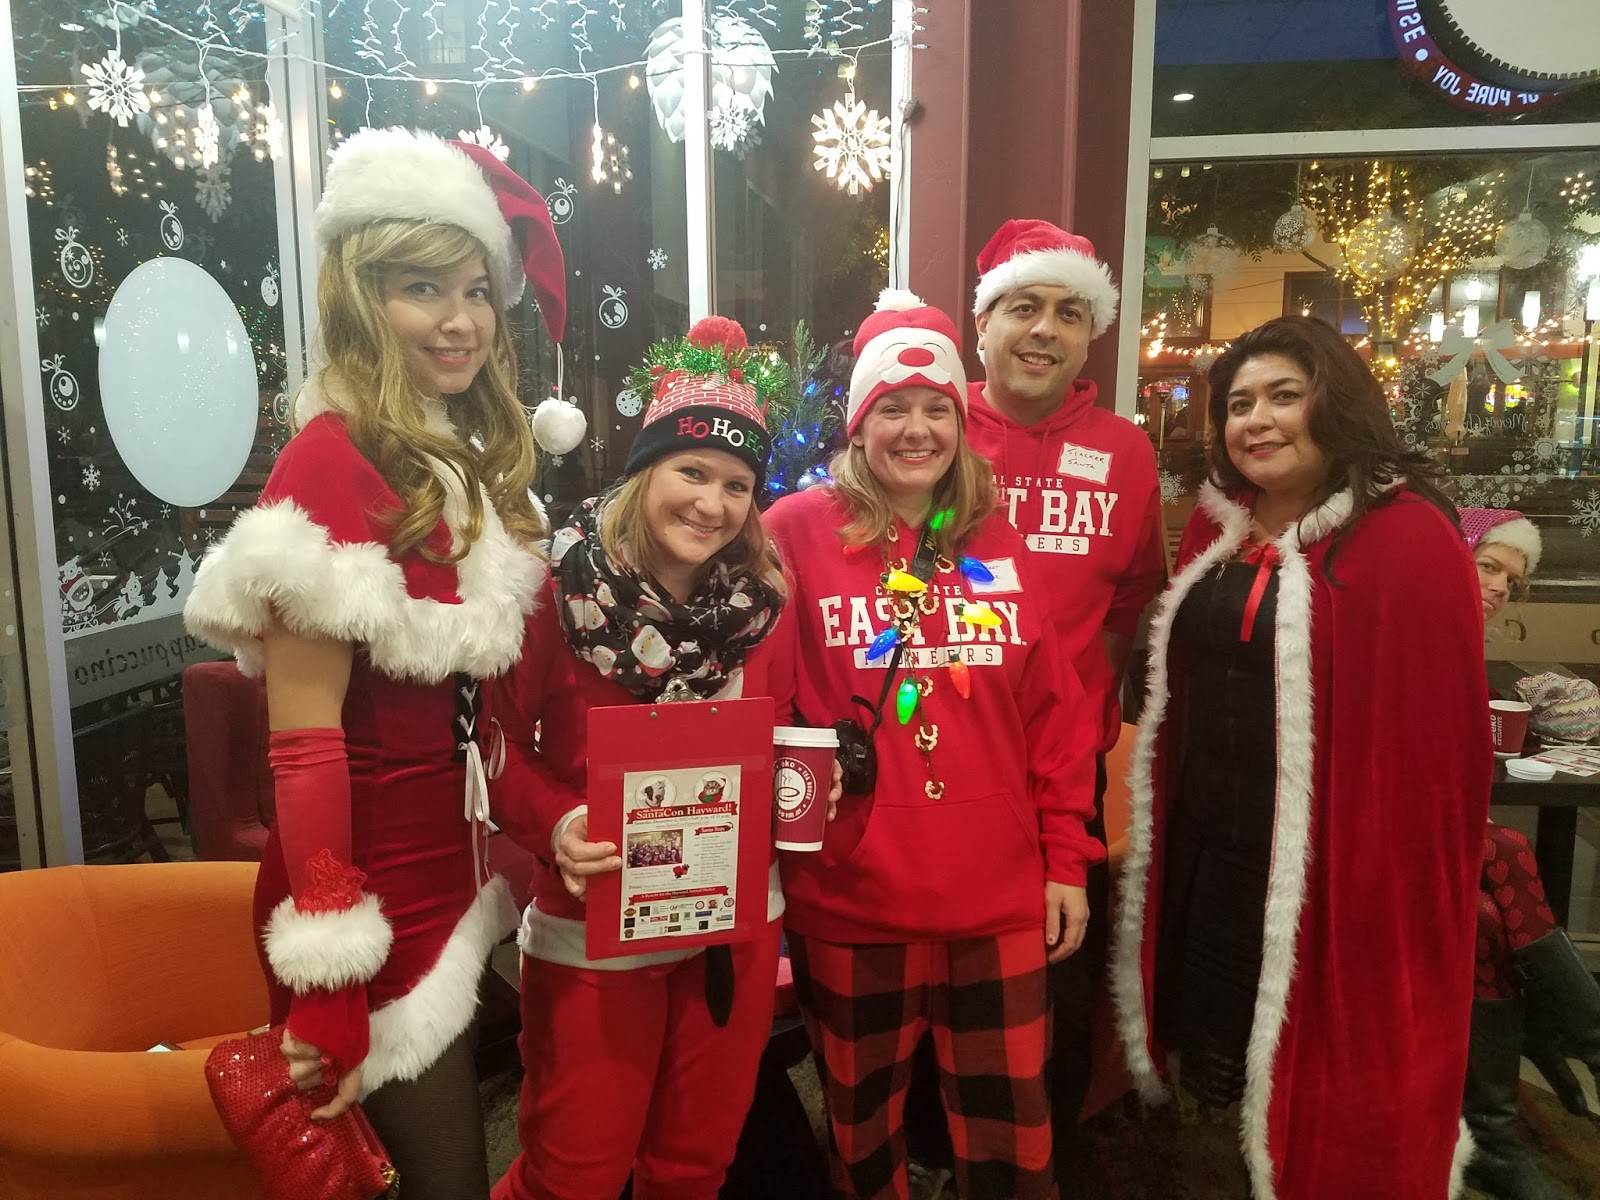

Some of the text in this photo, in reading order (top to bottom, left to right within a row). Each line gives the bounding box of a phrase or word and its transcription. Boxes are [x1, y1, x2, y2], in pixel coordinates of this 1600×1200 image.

[1015, 476, 1063, 488] STATE
[636, 807, 684, 820] SantaCon
[687, 803, 732, 815] Hayward!
